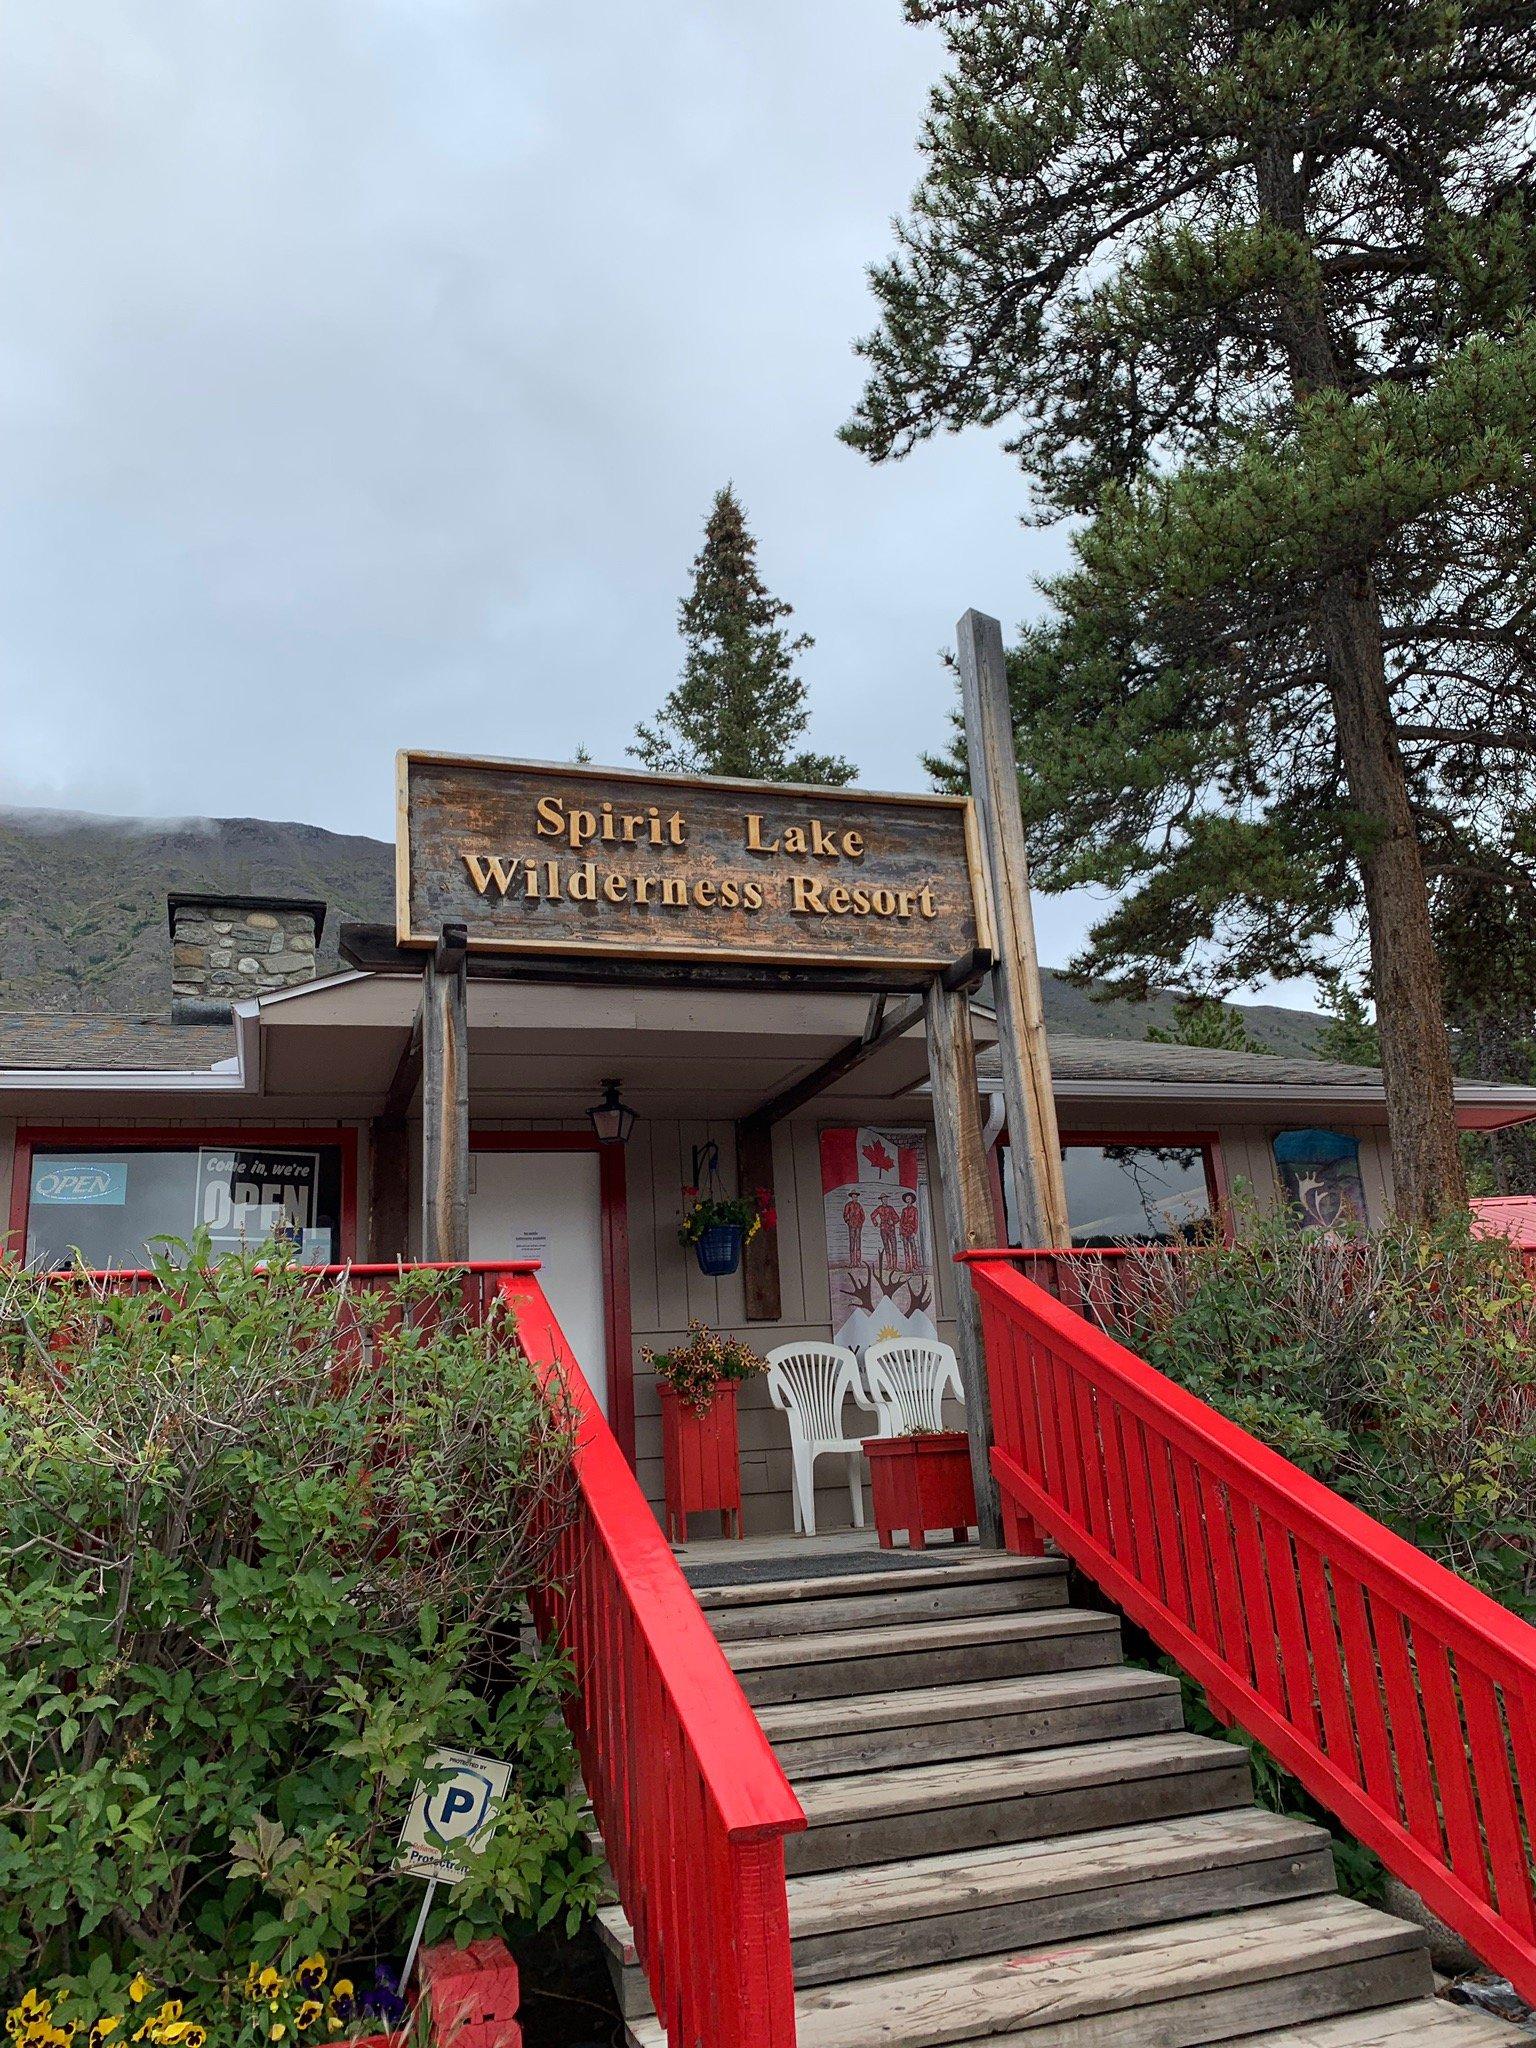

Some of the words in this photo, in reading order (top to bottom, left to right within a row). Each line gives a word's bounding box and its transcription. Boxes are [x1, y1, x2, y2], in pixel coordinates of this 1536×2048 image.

[536, 796, 686, 847] Spirit
[745, 813, 865, 858] Lake
[461, 853, 763, 910] Wilderness
[789, 875, 936, 918] Resort
[36, 1173, 111, 1196] OPEN
[206, 1157, 247, 1174] Come
[250, 1160, 268, 1177] in,
[272, 1163, 310, 1177] we're
[204, 1180, 309, 1230] OPEN
[449, 1757, 479, 1769] PROTECTED
[440, 1786, 475, 1824] P
